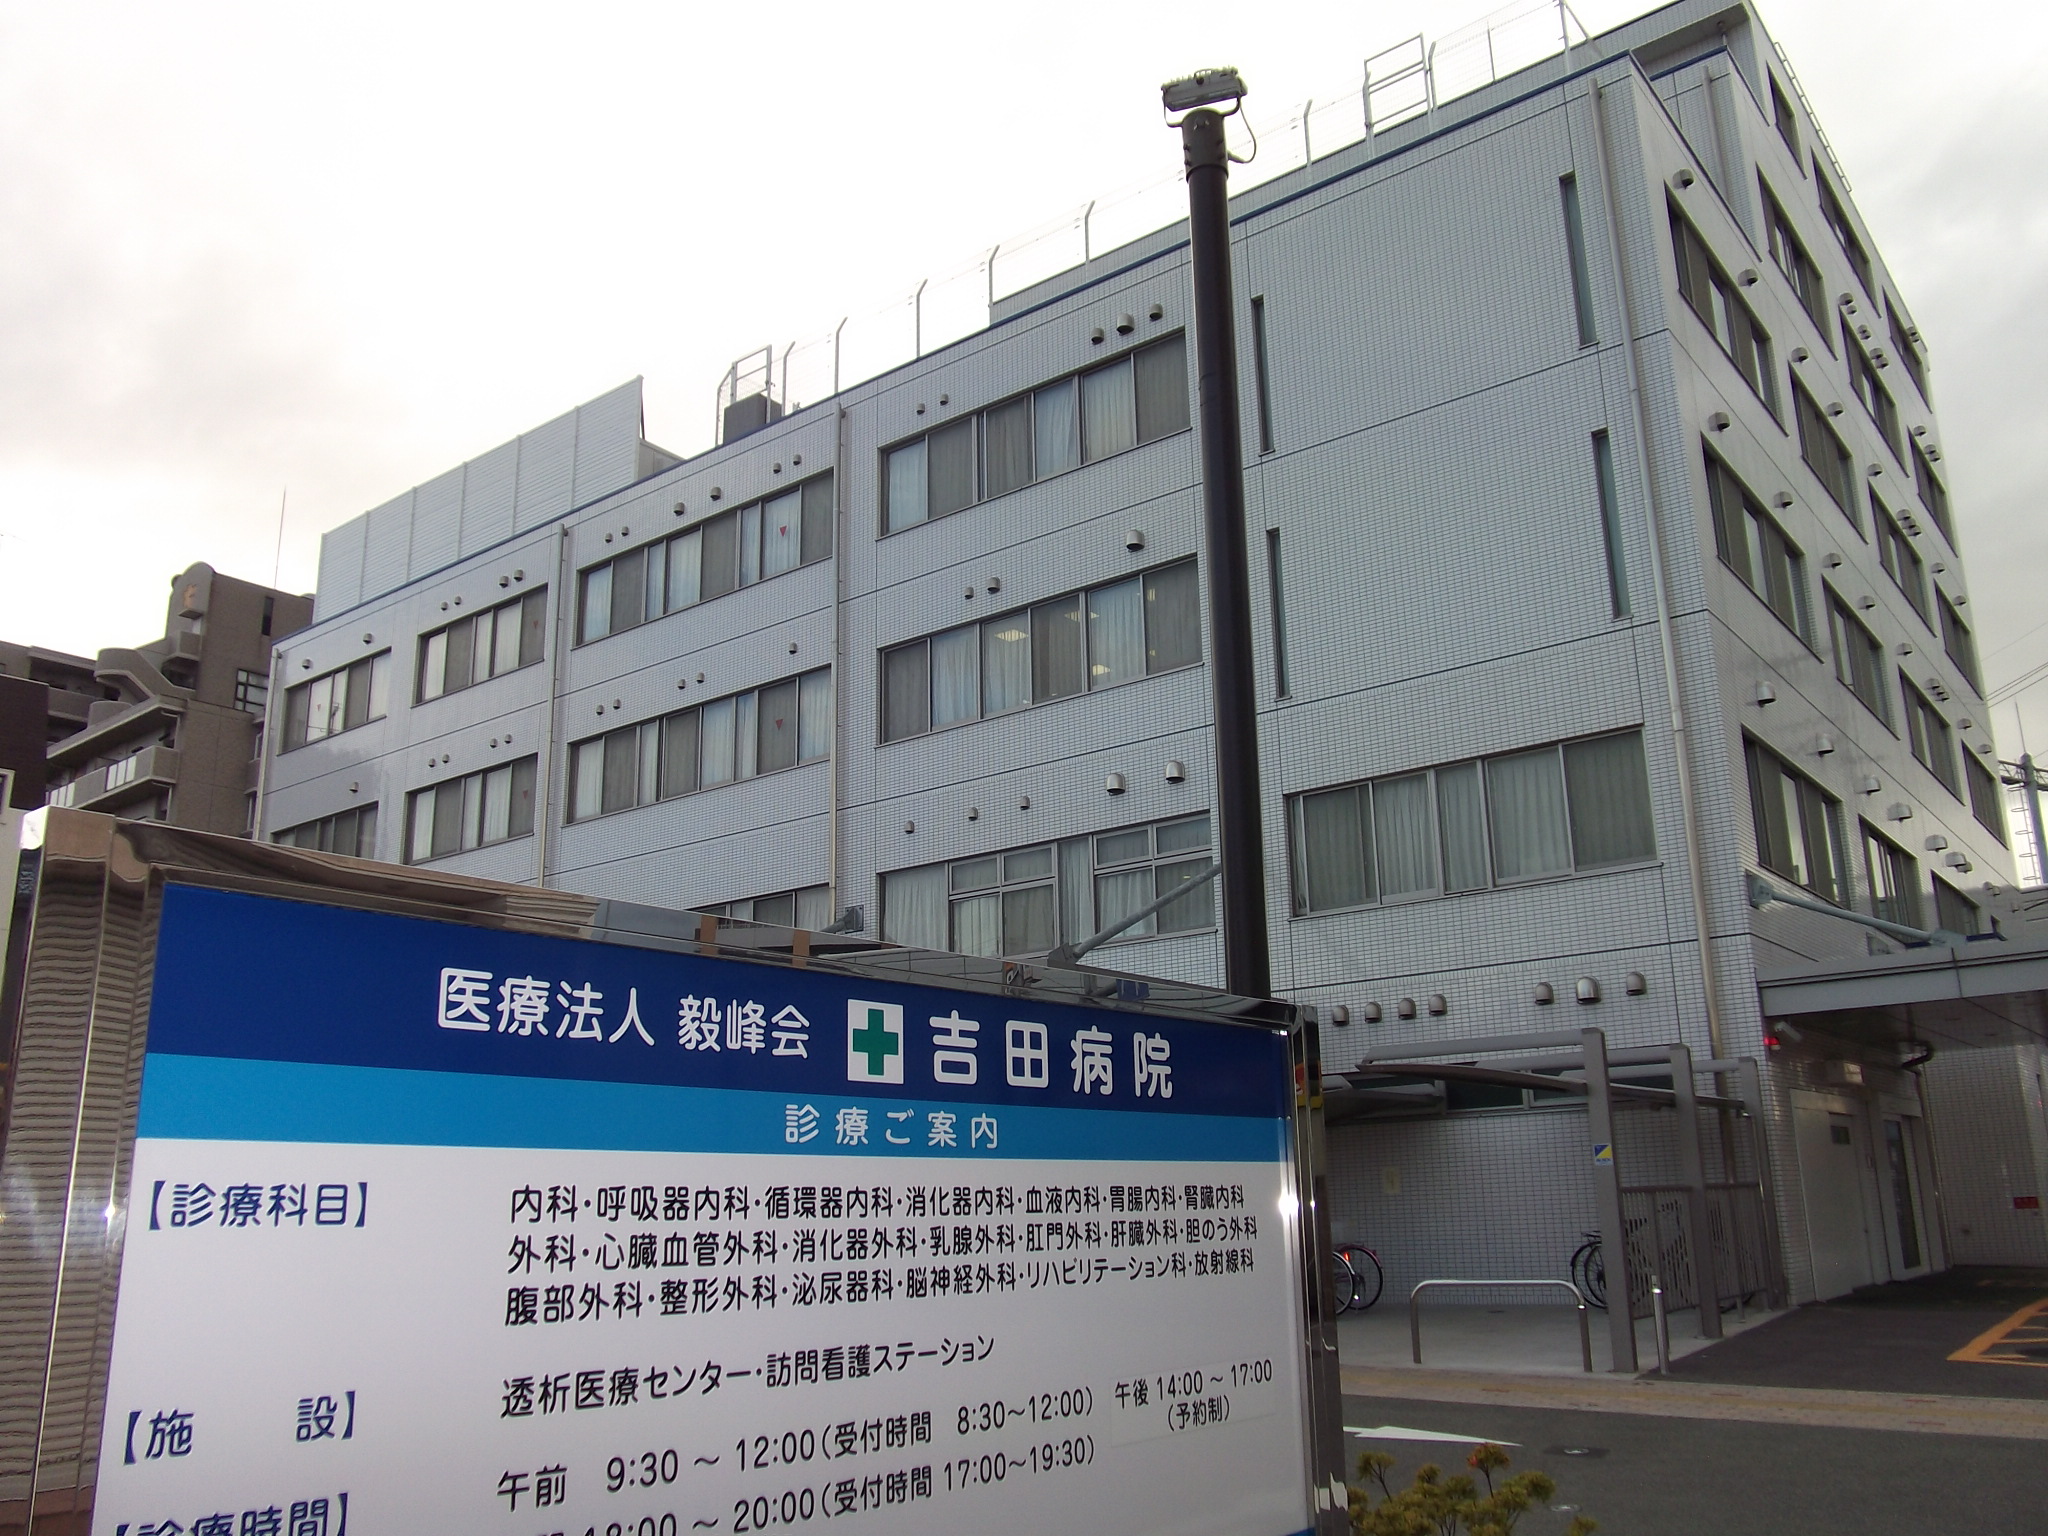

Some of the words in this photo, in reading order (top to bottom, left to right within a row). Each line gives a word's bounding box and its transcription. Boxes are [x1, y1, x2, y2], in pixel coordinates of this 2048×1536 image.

[437, 966, 655, 1047] 医療法人
[677, 993, 810, 1059] 毅峰会
[928, 1009, 1173, 1099] 吉田病院
[785, 1103, 998, 1149] 診療ご案内
[1114, 1380, 1149, 1410] 午後
[1156, 1369, 1203, 1401] 14:00
[1230, 1358, 1273, 1388] 17:00
[496, 1463, 568, 1512] 午前
[606, 1448, 679, 1493] 9:30
